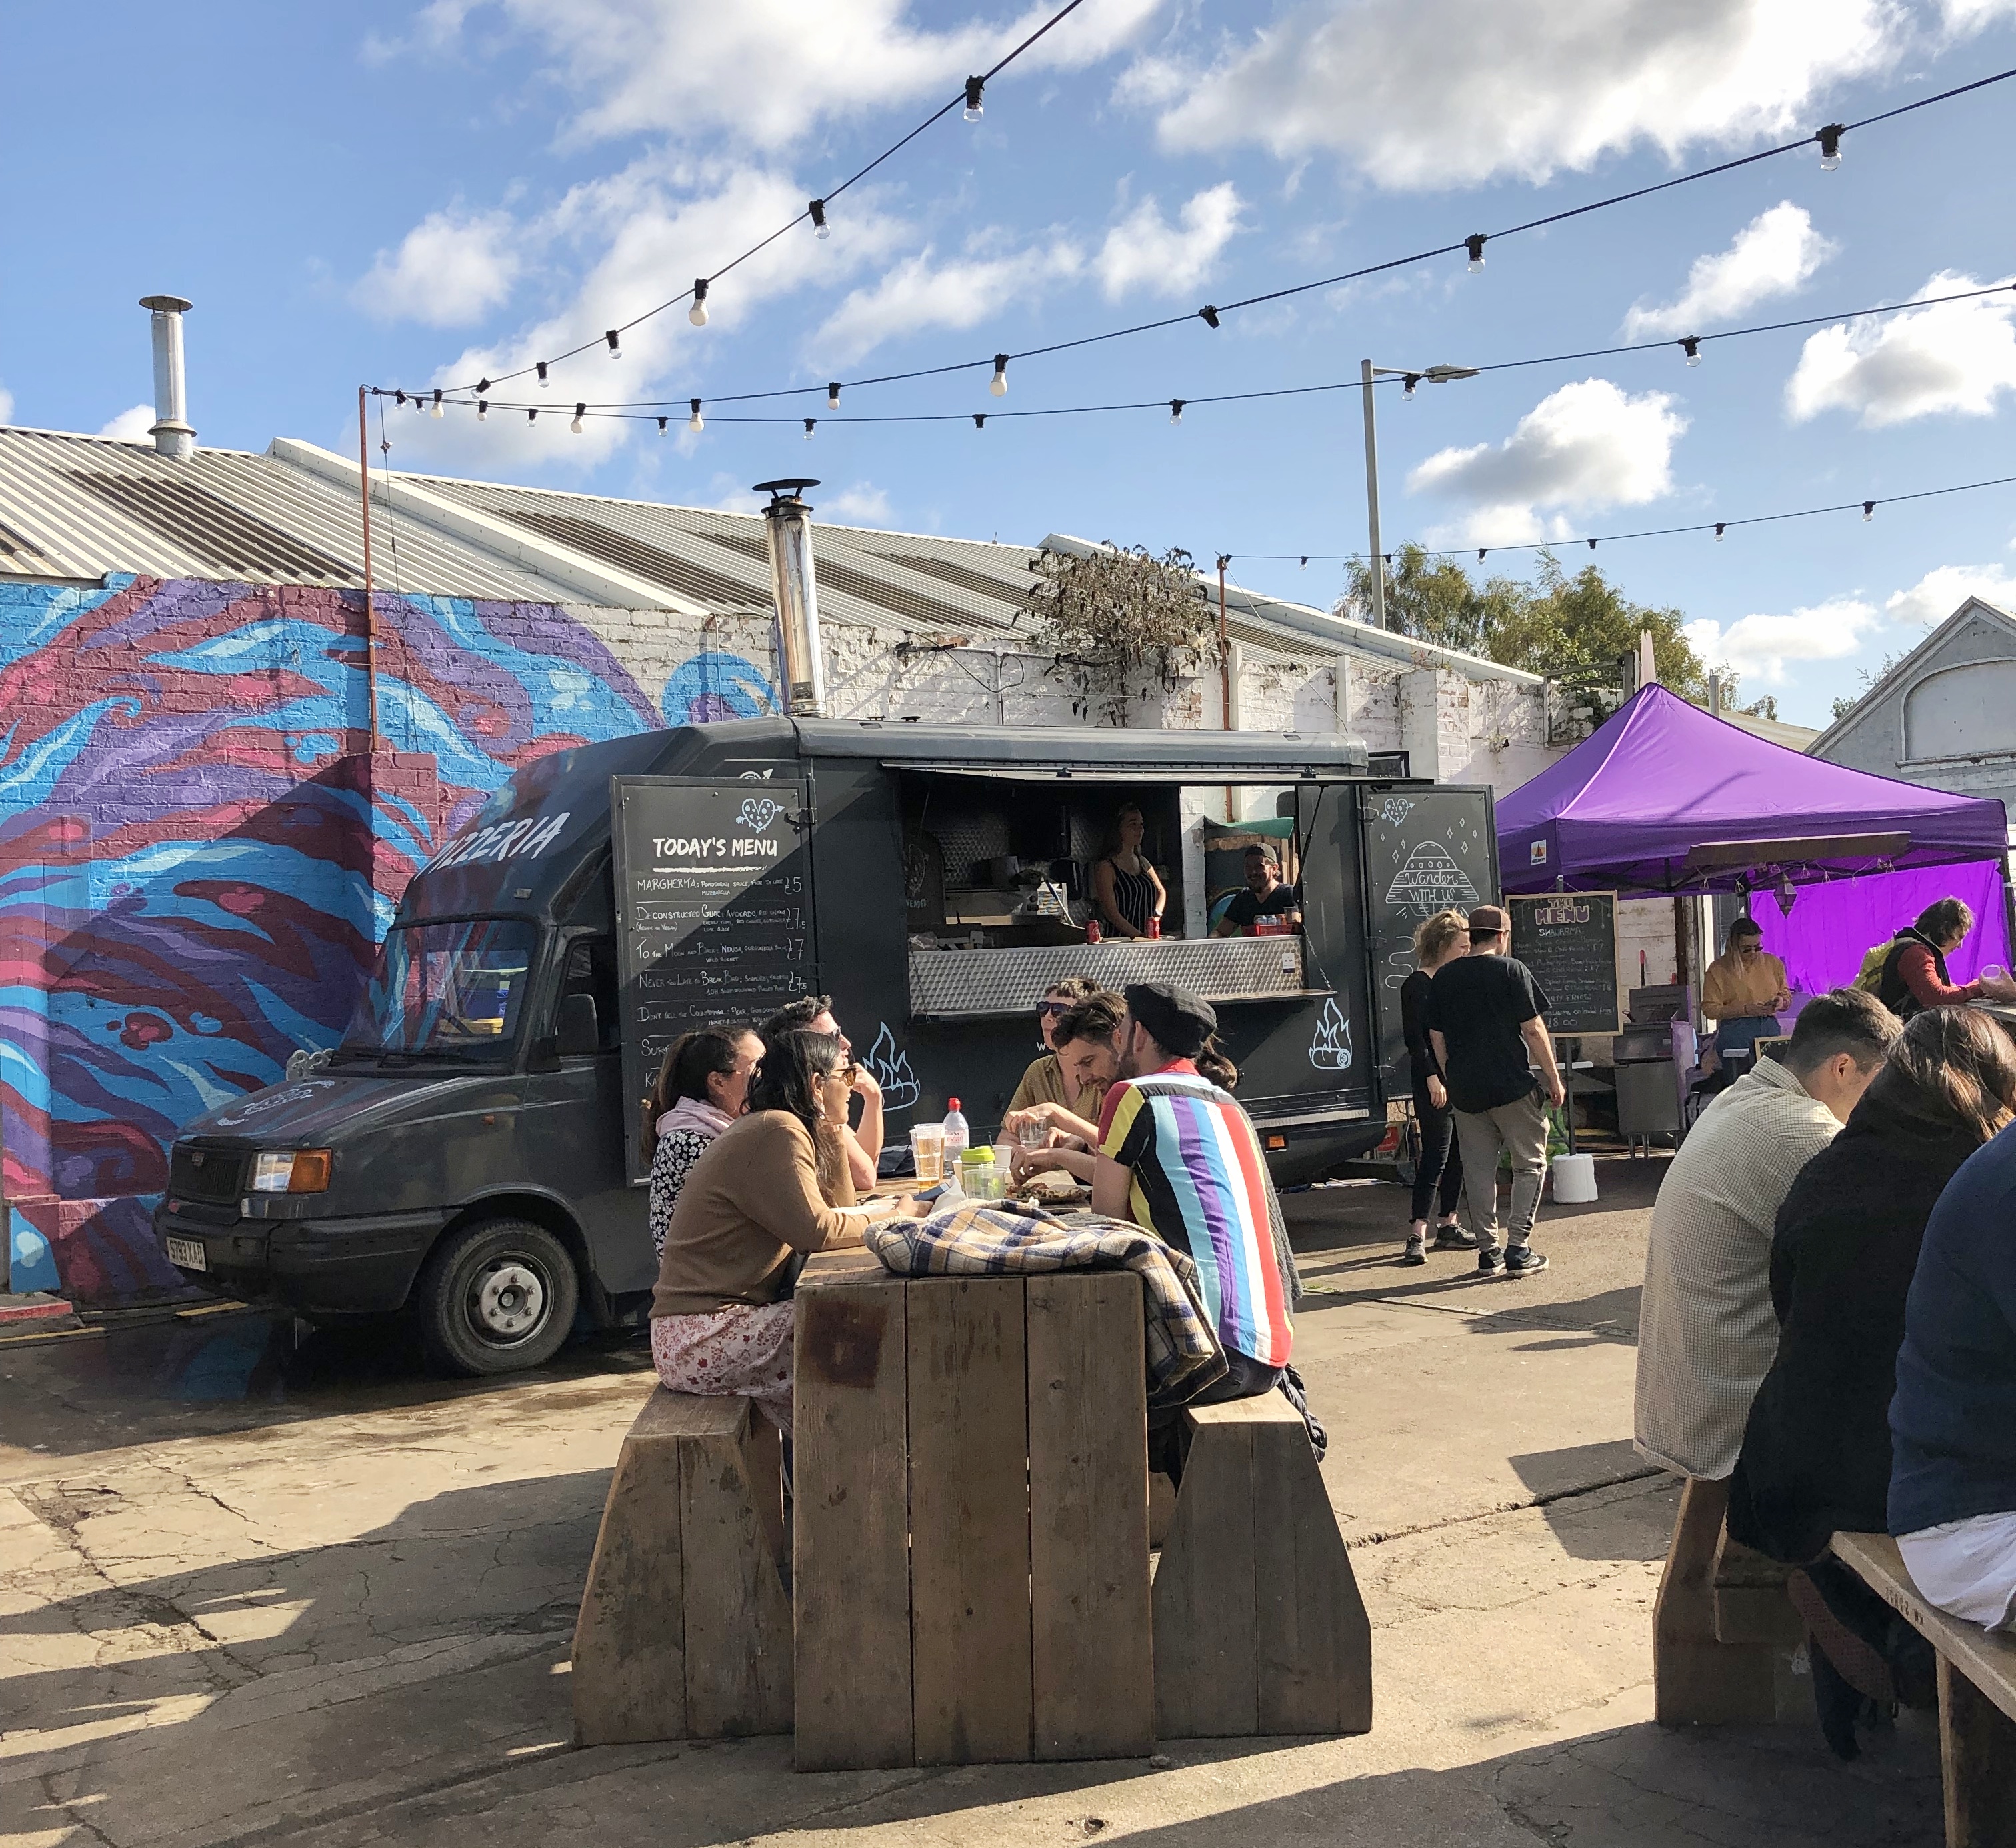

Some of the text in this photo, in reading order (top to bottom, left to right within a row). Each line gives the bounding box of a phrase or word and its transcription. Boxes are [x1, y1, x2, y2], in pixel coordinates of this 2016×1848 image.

[414, 811, 570, 881] PIZZERIA
[652, 837, 777, 859] TODAY'S MENU
[1404, 871, 1459, 885] Wander
[1408, 889, 1437, 902] WITH
[1547, 897, 1574, 909] THE
[1534, 905, 1590, 925] MENU
